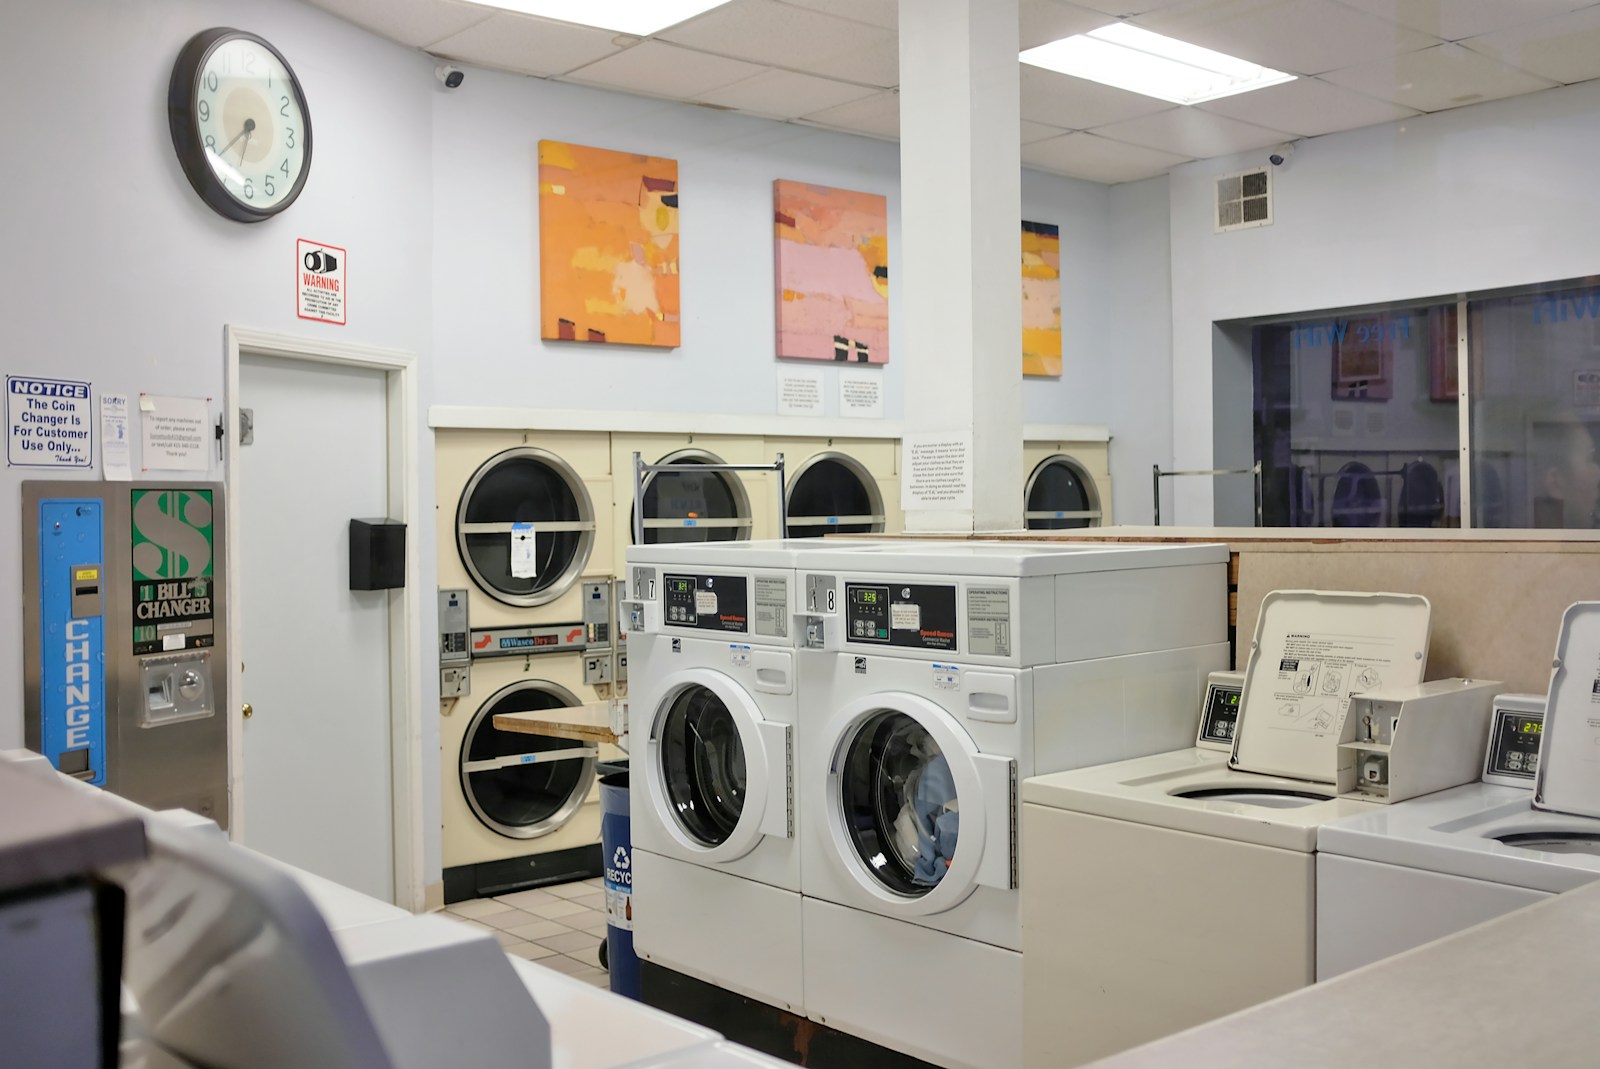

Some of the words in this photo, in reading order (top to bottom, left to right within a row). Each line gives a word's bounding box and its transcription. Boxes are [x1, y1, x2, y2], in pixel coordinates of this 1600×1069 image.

[203, 70, 218, 92] 10
[199, 100, 210, 122] 9
[280, 96, 290, 118] 2
[286, 127, 294, 149] 3
[280, 158, 290, 178] 4
[244, 178, 254, 200] 6
[264, 175, 274, 197] 5
[303, 272, 339, 292] WARNING
[15, 382, 85, 398] NOTICE
[27, 398, 48, 409] The
[52, 400, 75, 411] Coin
[102, 397, 126, 406] SORRY
[22, 412, 68, 426] Changer
[72, 415, 80, 425] Is
[14, 426, 32, 436] For
[36, 427, 88, 438] Customer
[22, 440, 44, 450] Use
[48, 441, 80, 454] Only...
[158, 582, 191, 600] BILL
[650, 580, 655, 598] 7
[864, 592, 876, 603] 325
[136, 598, 210, 619] CHANGER
[828, 590, 834, 610] 8
[66, 620, 90, 750] CHANGE
[607, 868, 632, 884] RECYC
